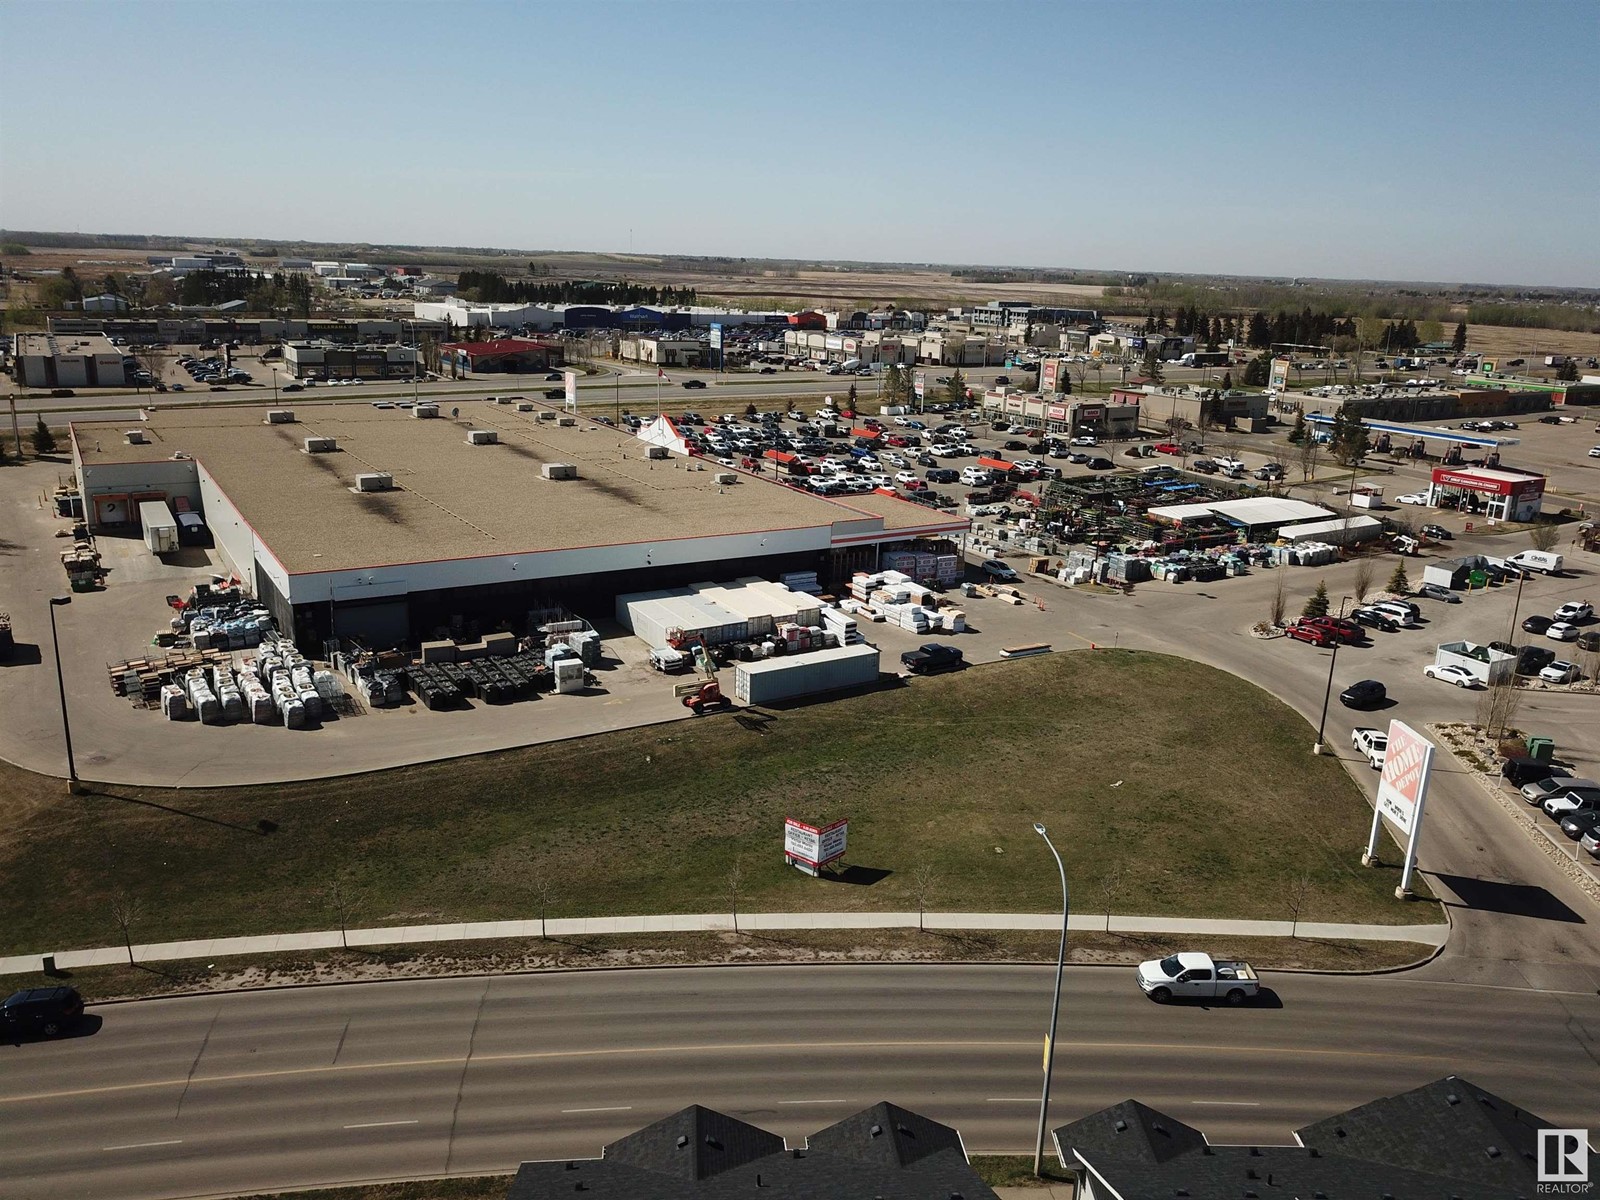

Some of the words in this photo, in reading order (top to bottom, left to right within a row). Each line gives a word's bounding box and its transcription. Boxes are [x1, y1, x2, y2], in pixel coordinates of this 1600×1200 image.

[1390, 735, 1406, 754] THE
[1384, 741, 1421, 783] HOME
[1395, 767, 1420, 791] DEPOT
